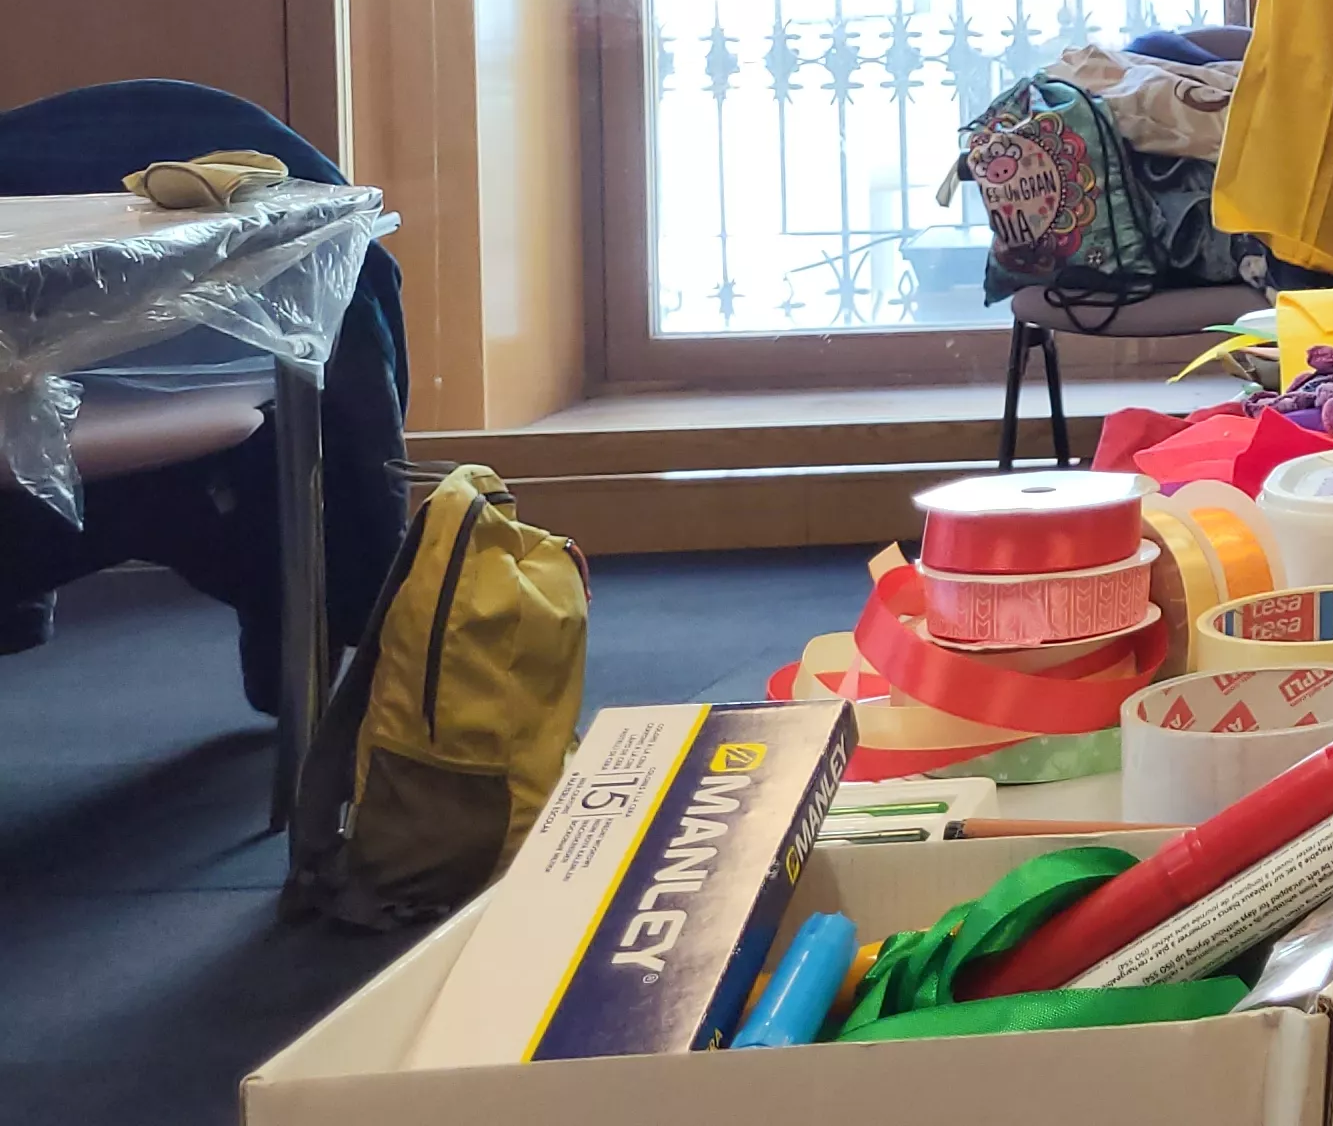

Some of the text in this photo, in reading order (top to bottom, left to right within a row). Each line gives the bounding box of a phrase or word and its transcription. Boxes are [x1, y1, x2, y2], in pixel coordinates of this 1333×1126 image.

[1020, 171, 1057, 200] GRAN
[1252, 594, 1302, 618] tesa
[1249, 616, 1301, 640] tesa
[1284, 668, 1325, 700] APLI
[582, 778, 639, 809] 15
[795, 733, 847, 863] MANLEY
[611, 776, 750, 972] MANLEY
